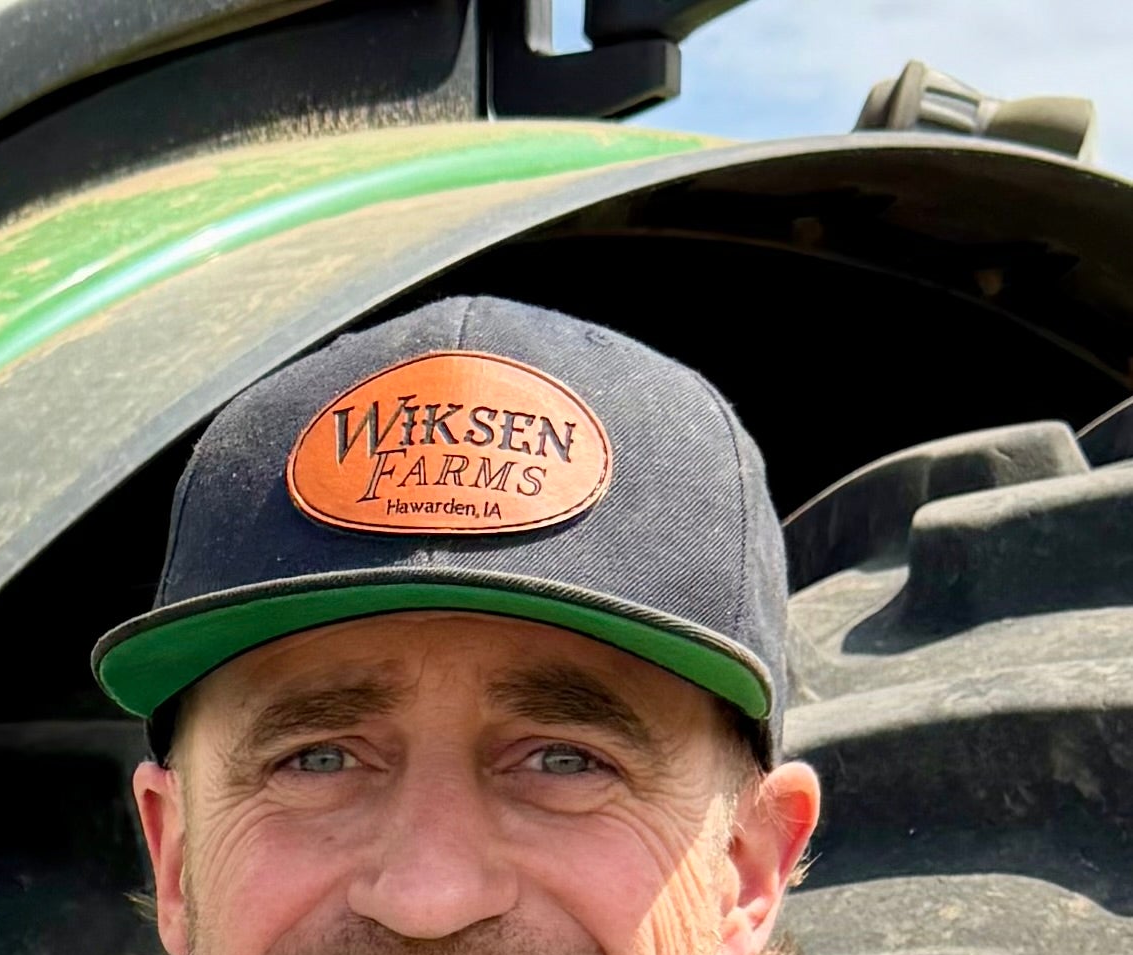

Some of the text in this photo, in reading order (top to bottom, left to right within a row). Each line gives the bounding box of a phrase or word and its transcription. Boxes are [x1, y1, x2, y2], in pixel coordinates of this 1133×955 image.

[332, 394, 577, 465] WIKSEN
[356, 449, 549, 504] FARMS
[386, 498, 502, 520] Hawarden, IA
